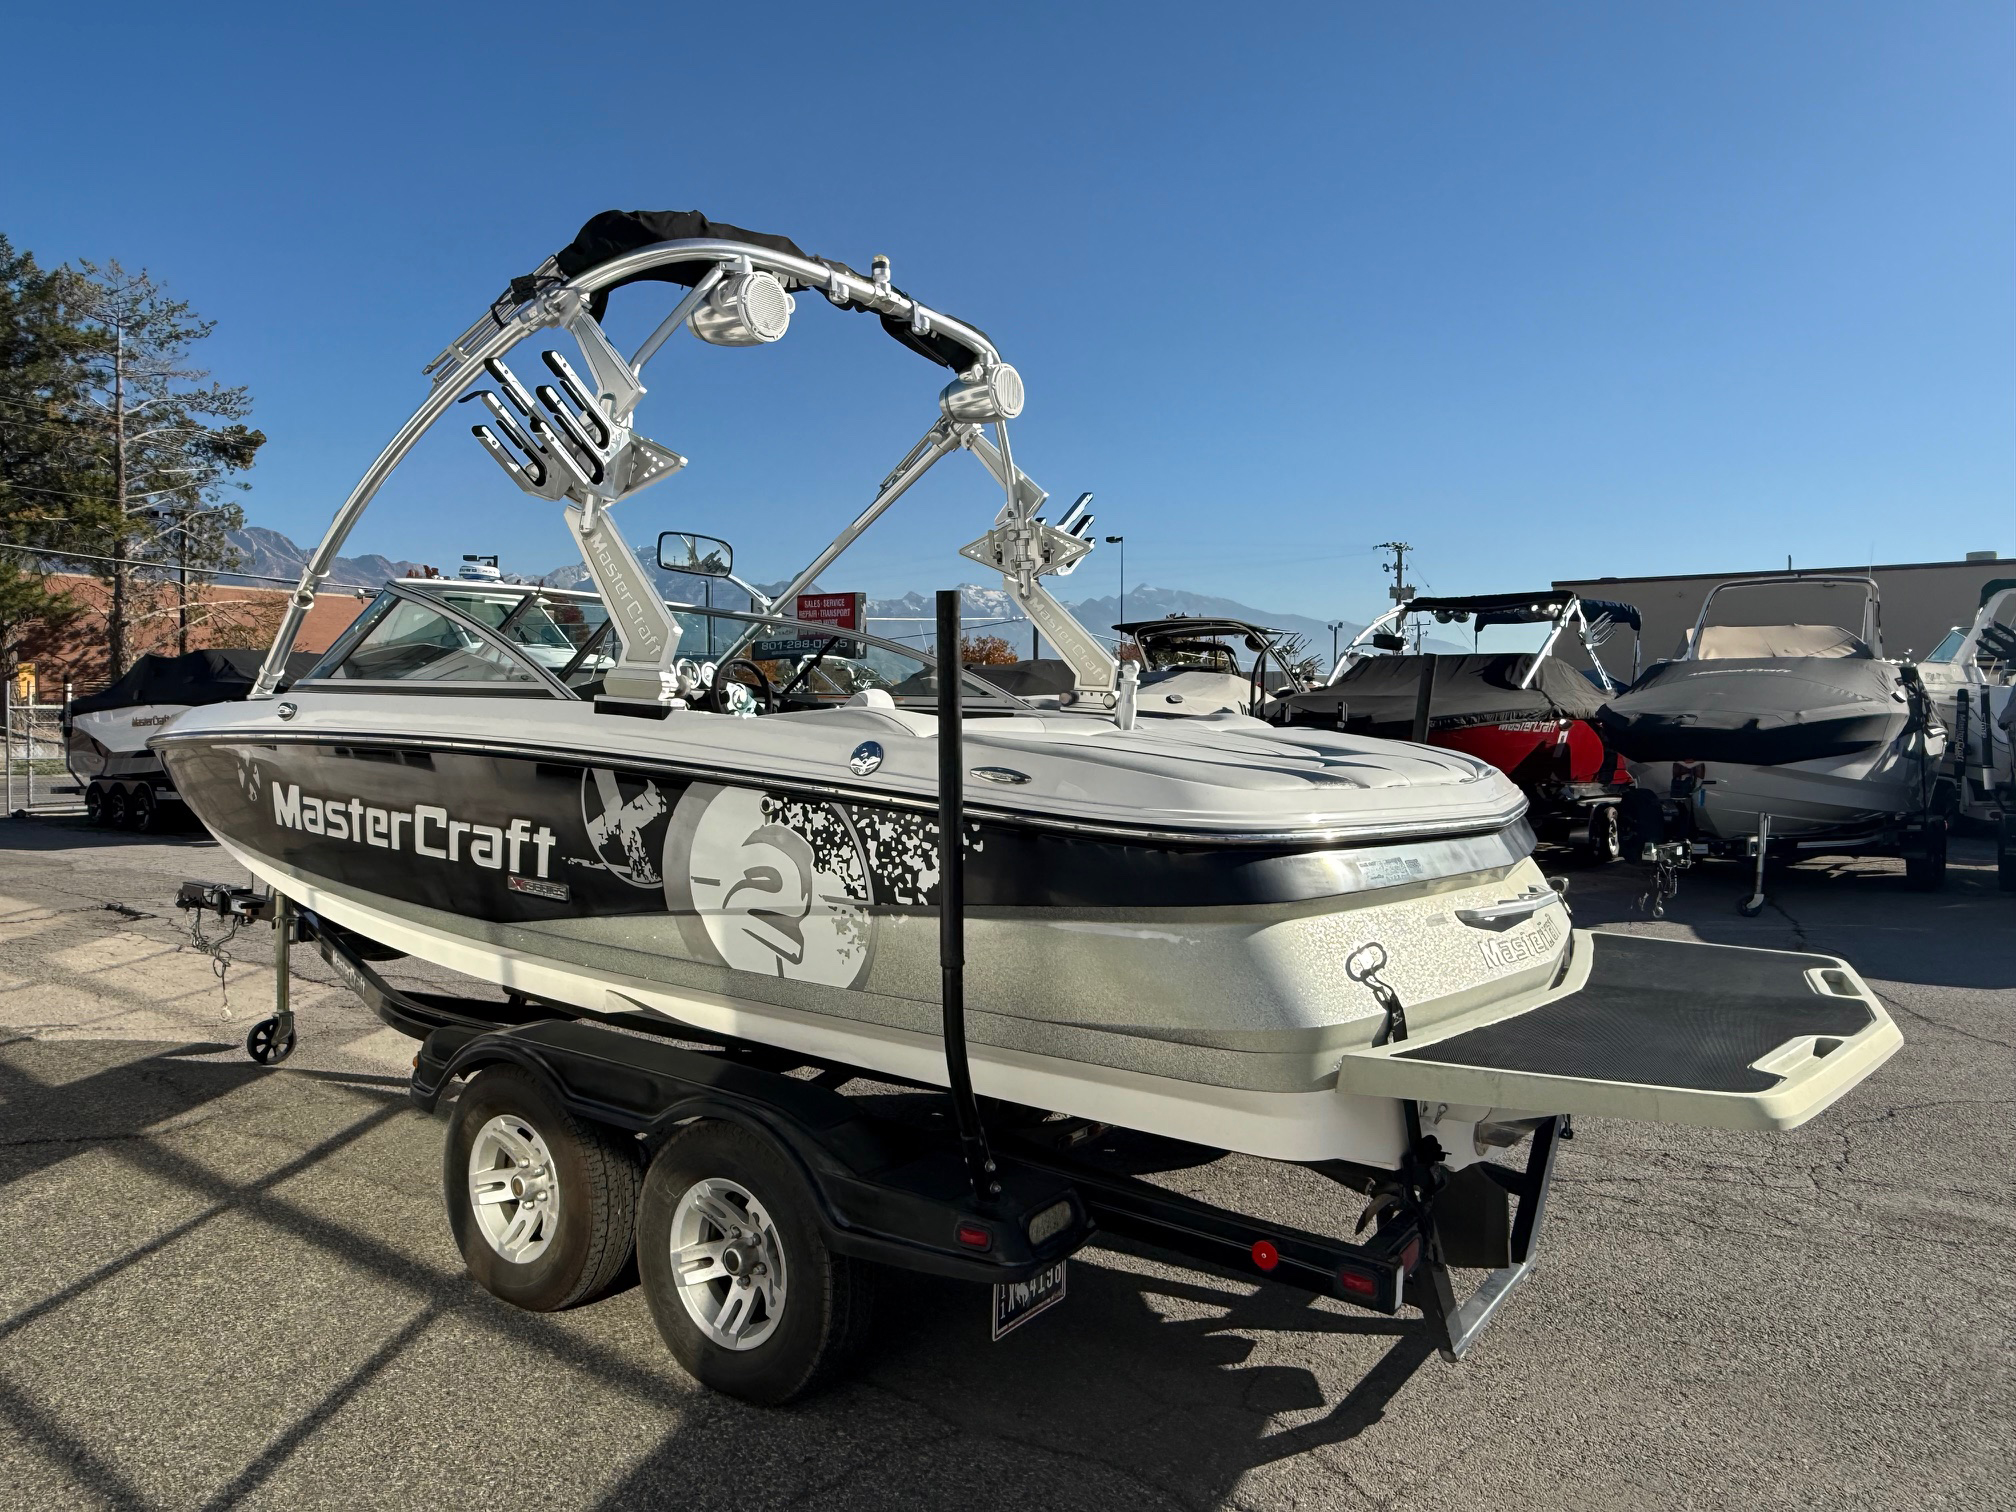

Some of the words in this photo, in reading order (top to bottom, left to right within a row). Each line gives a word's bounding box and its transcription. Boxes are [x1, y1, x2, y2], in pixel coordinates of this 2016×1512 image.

[590, 532, 661, 655] MasterCraft
[1030, 597, 1108, 681] MasterCraft
[271, 780, 557, 878] MasterCraft
